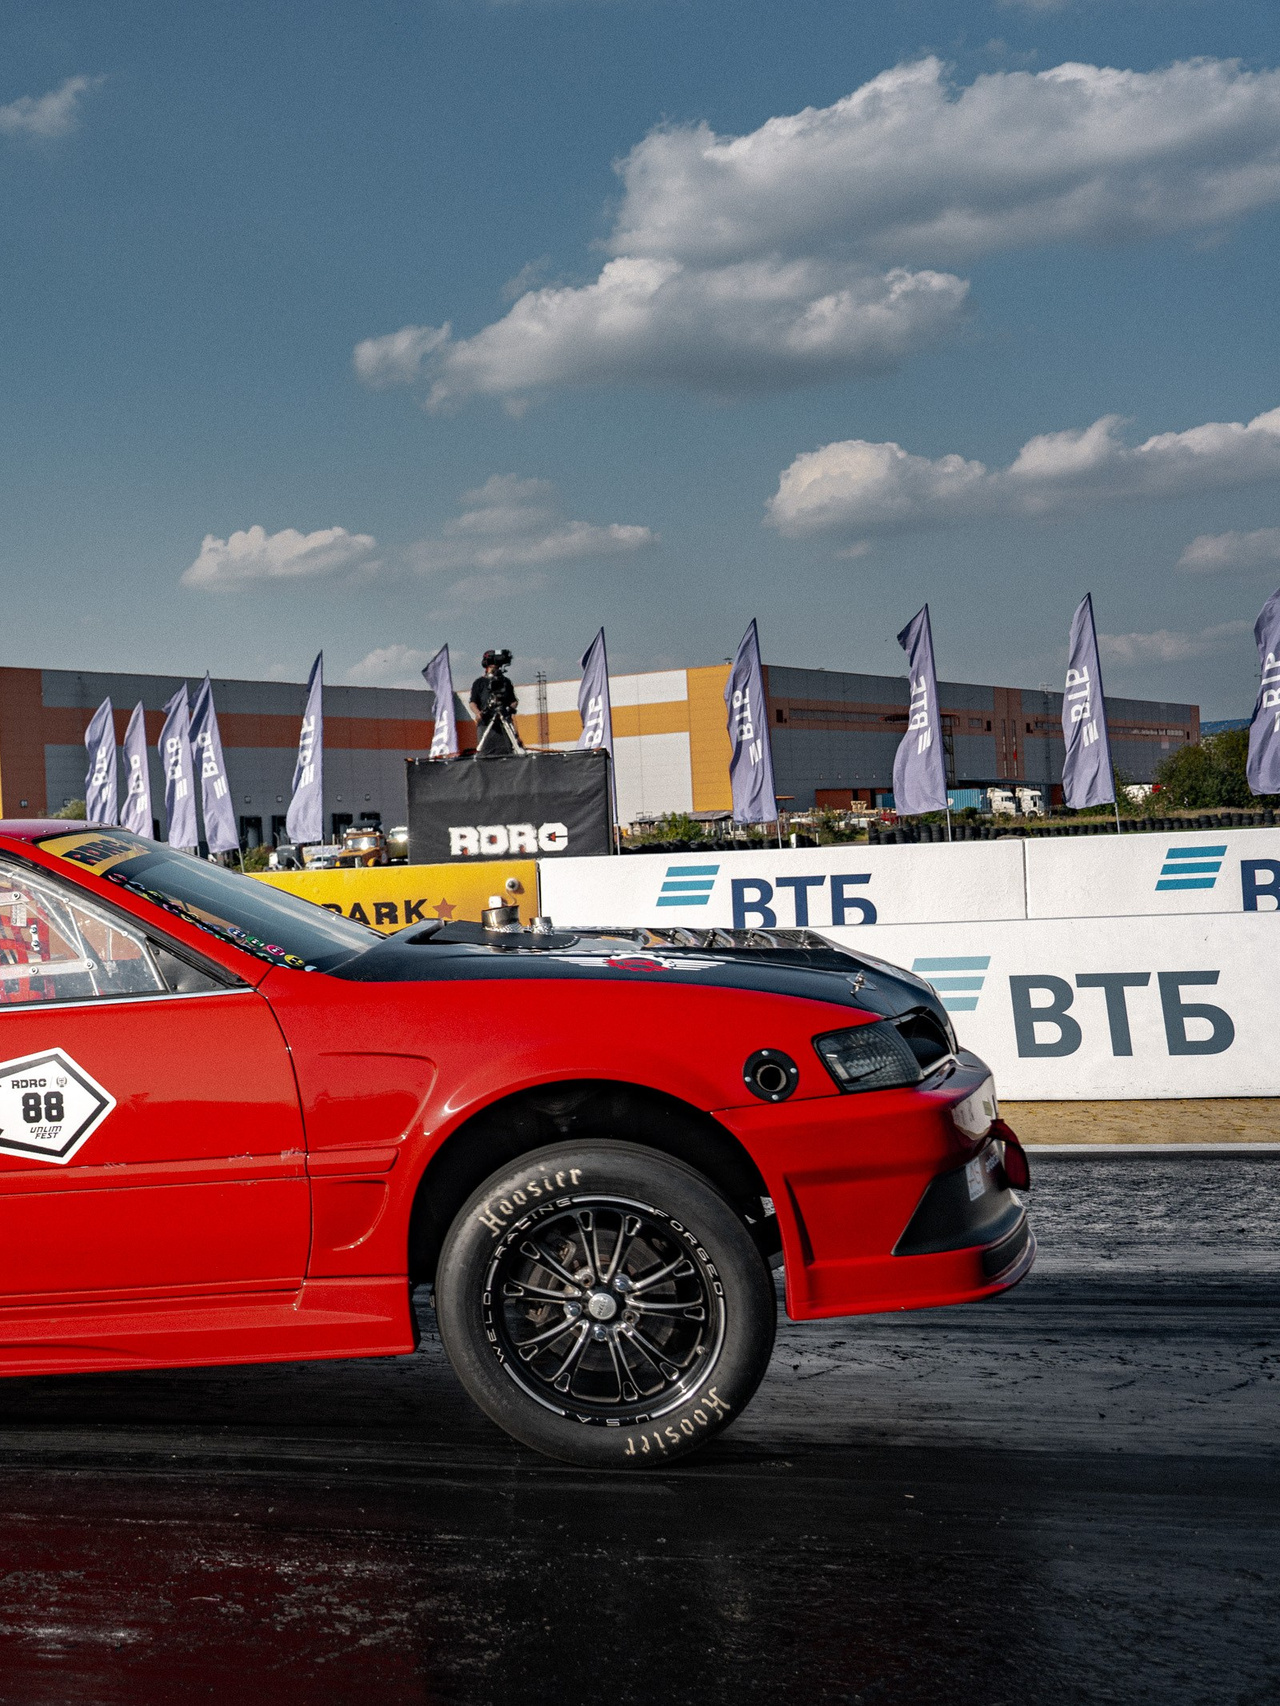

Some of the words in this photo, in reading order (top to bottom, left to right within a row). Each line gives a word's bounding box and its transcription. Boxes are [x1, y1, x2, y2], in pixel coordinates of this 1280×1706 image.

[731, 873, 878, 930] ВТБ
[1009, 970, 1236, 1058] ВТБ
[21, 1090, 65, 1124] 88
[35, 1132, 59, 1140] FEST
[483, 1291, 505, 1363] WELD
[494, 1197, 572, 1259] RACING
[653, 1208, 724, 1296] FORGED
